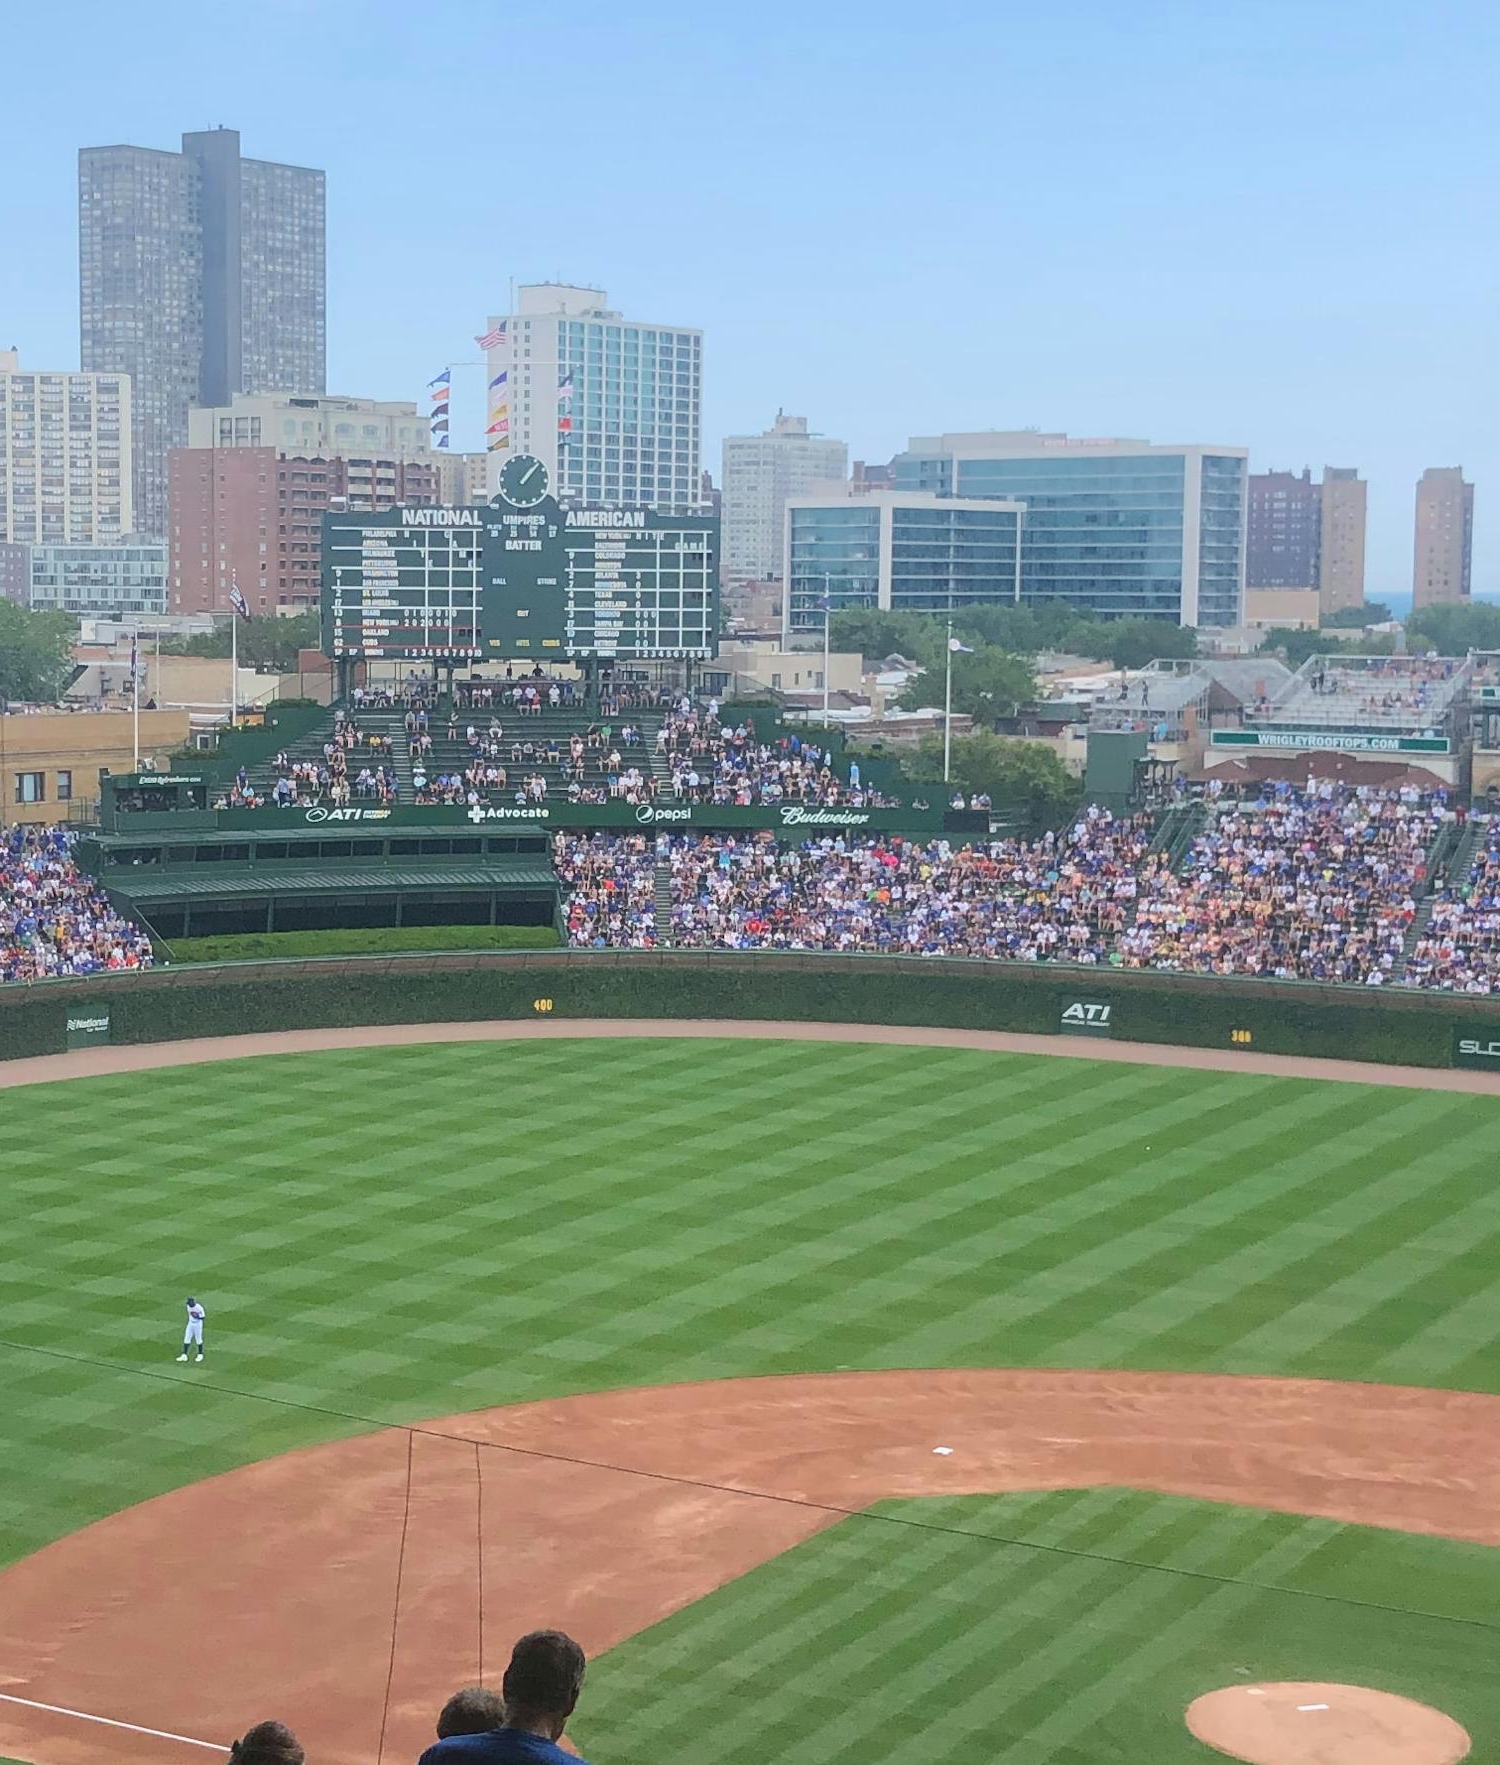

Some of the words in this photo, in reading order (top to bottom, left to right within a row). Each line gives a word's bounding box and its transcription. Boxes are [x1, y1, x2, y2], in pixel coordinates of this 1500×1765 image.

[402, 509, 483, 526] NATIONAL
[502, 514, 546, 526] UMPIRES
[565, 511, 645, 527] AMERICAN
[505, 540, 542, 551] BATTER
[1257, 733, 1400, 750] WRIGLEYROOFTOPS.COM
[327, 808, 361, 821] ATI
[486, 807, 550, 819] Advocate
[655, 807, 691, 821] pepsi
[779, 806, 870, 825] Budweiser
[1061, 1002, 1111, 1021] ATI
